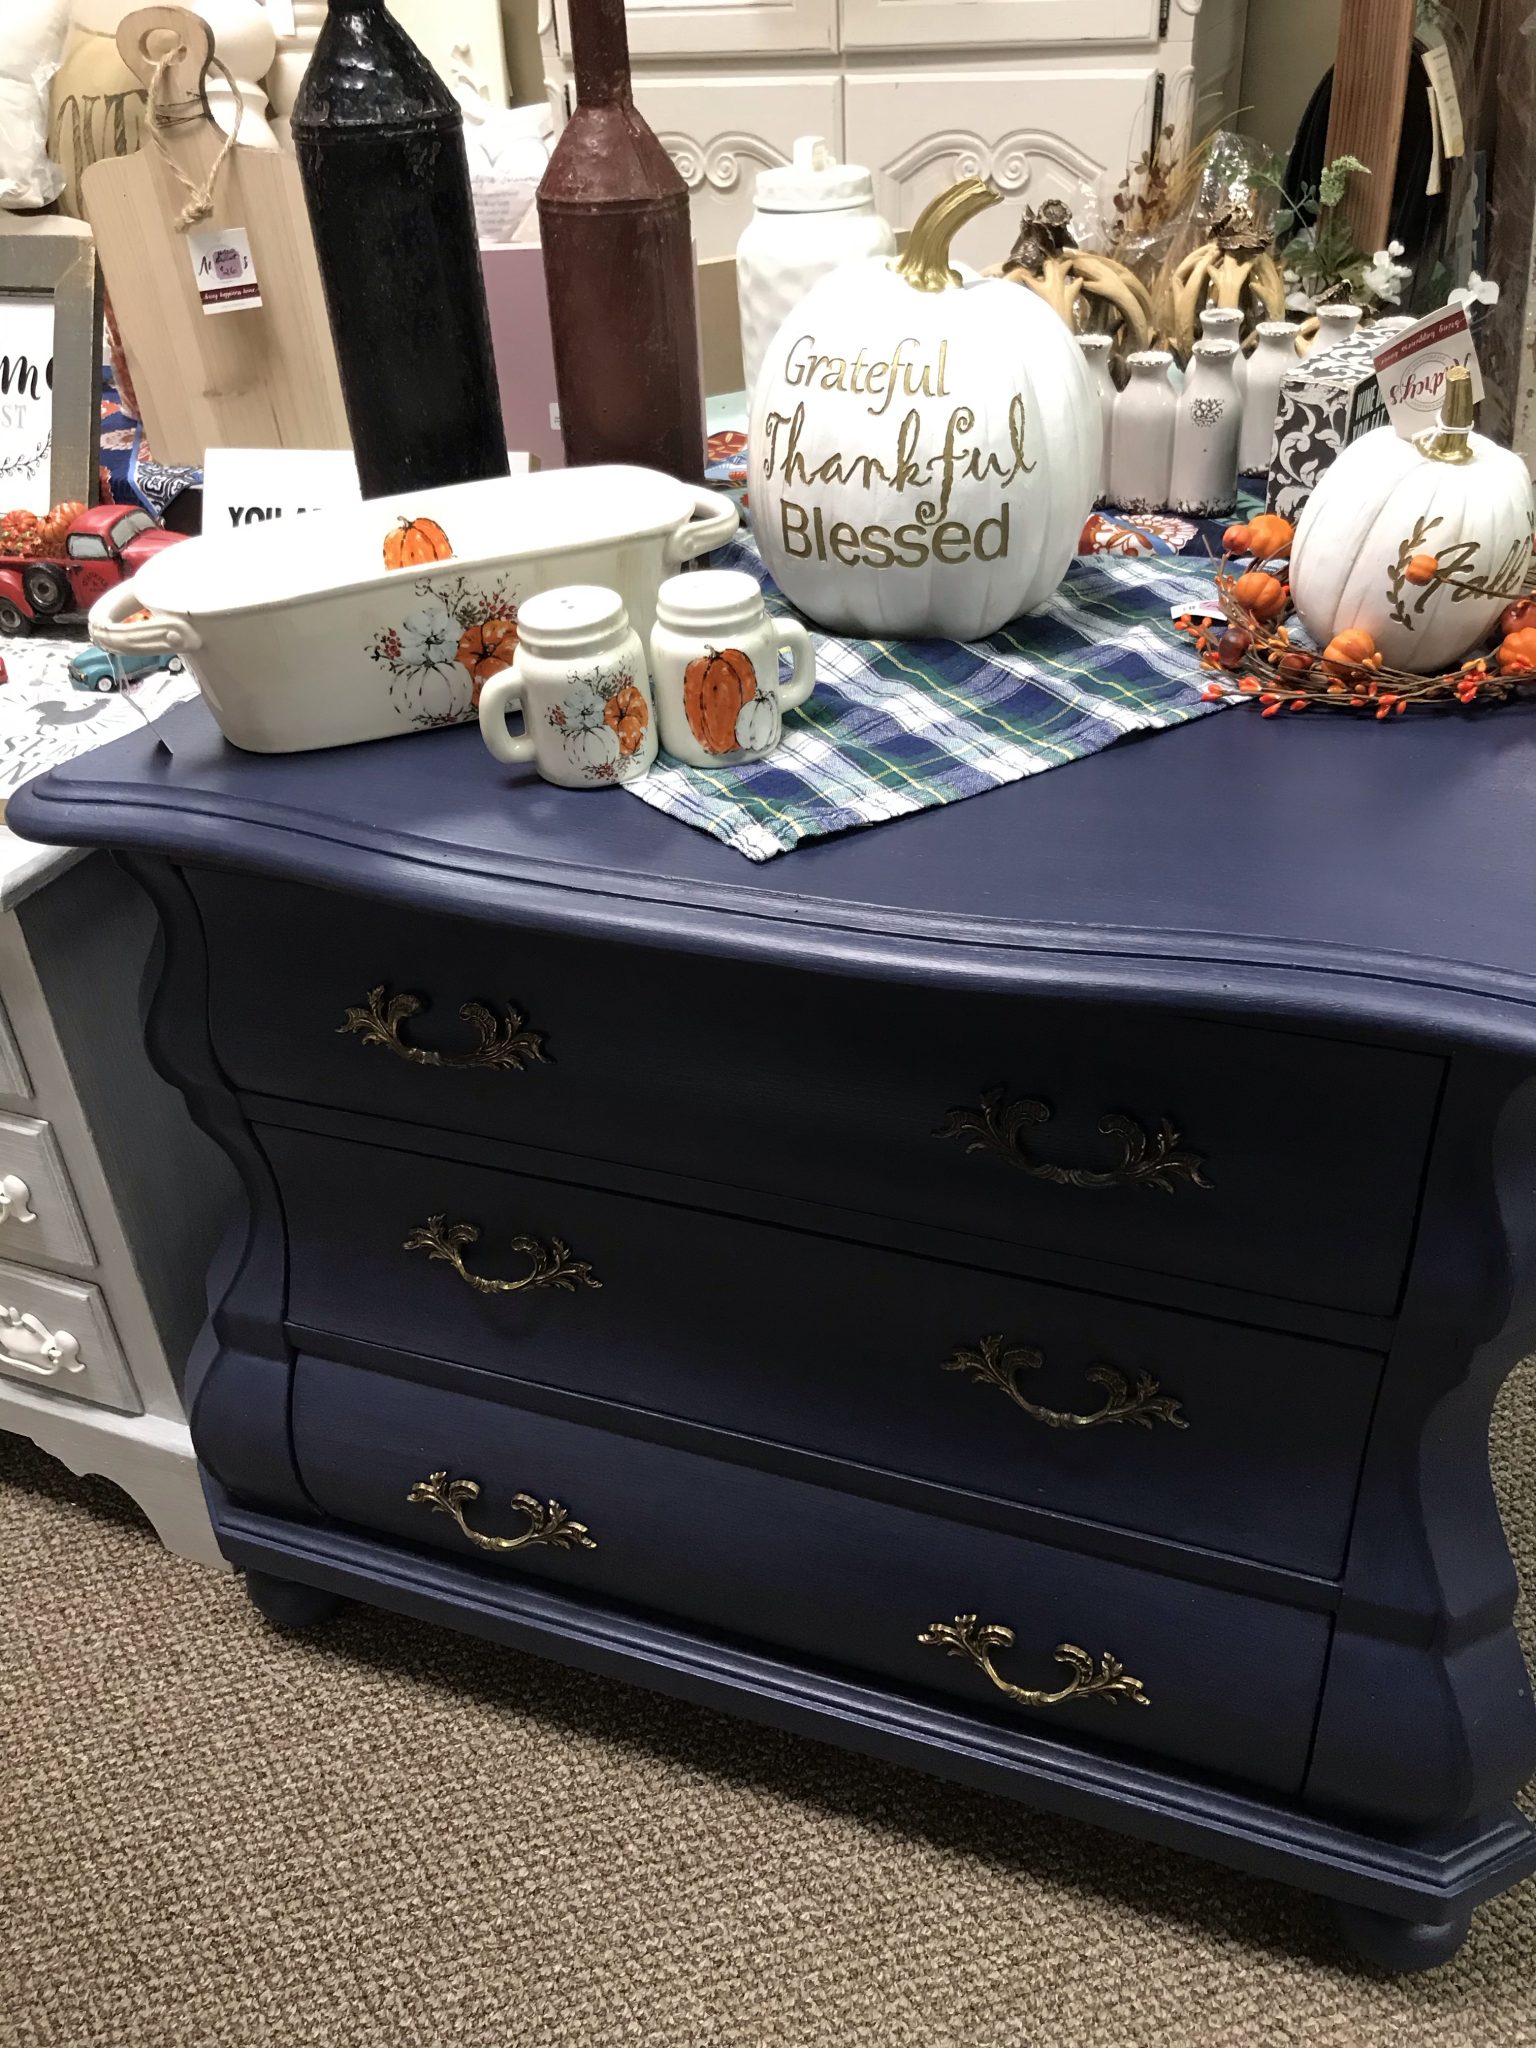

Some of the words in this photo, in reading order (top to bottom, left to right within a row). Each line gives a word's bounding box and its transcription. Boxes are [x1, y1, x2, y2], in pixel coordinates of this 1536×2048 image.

[785, 335, 950, 416] Grateful
[763, 392, 1037, 526] Thankful
[780, 498, 1010, 570] Blessed
[1414, 536, 1530, 614] Fall
